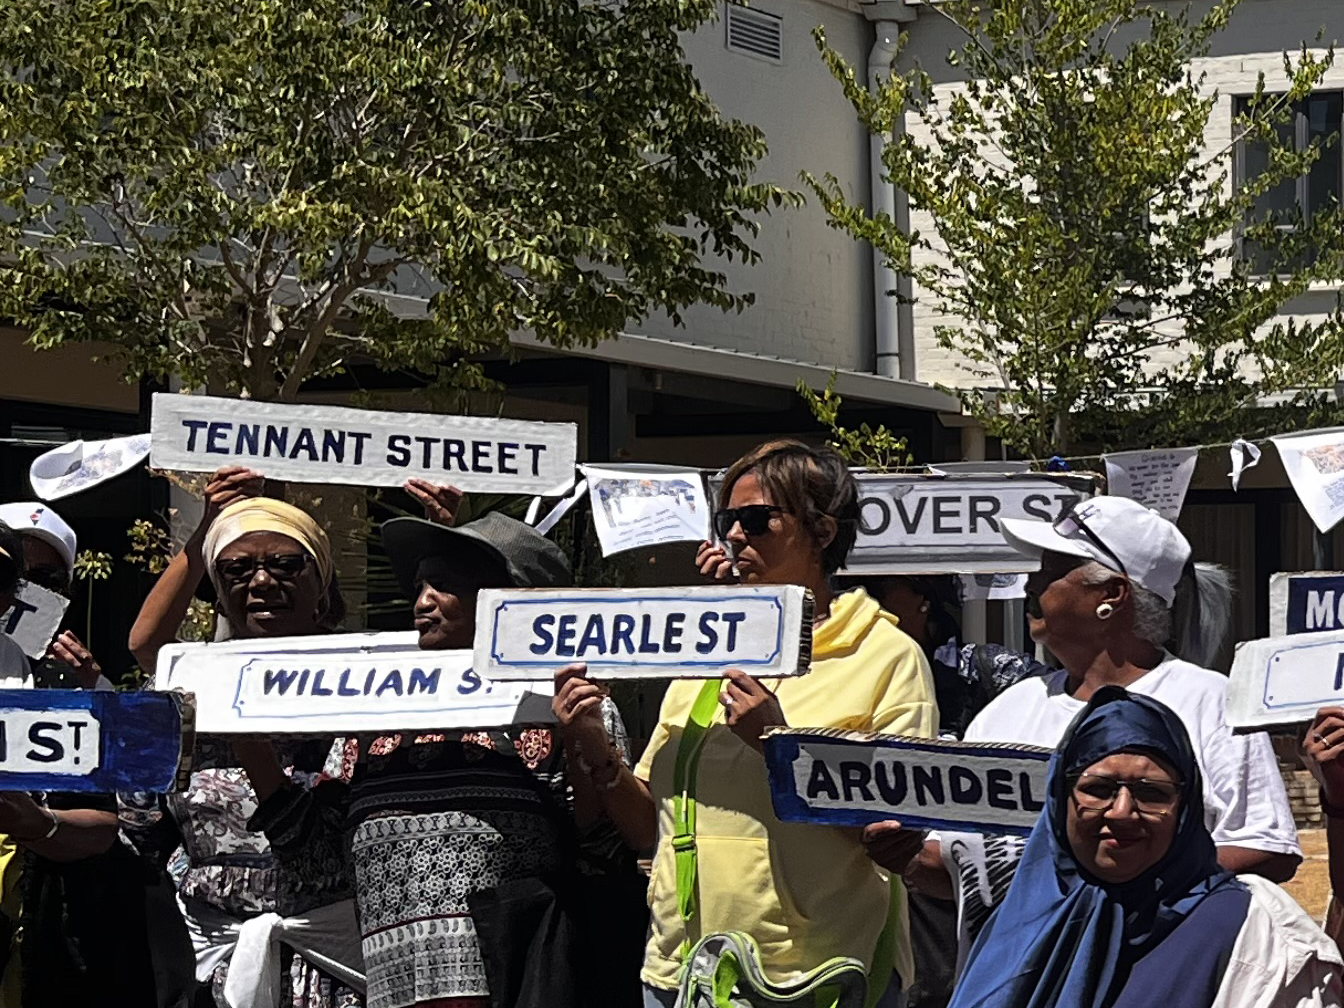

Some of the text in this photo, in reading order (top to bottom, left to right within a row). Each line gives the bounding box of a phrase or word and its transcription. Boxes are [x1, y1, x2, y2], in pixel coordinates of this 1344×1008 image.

[182, 420, 547, 477] TENNANT STREET
[859, 496, 1002, 536] OVER
[530, 611, 746, 657] SEARLE ST
[264, 668, 442, 696] WILLIAM
[807, 759, 1046, 812] ARUNDEL
